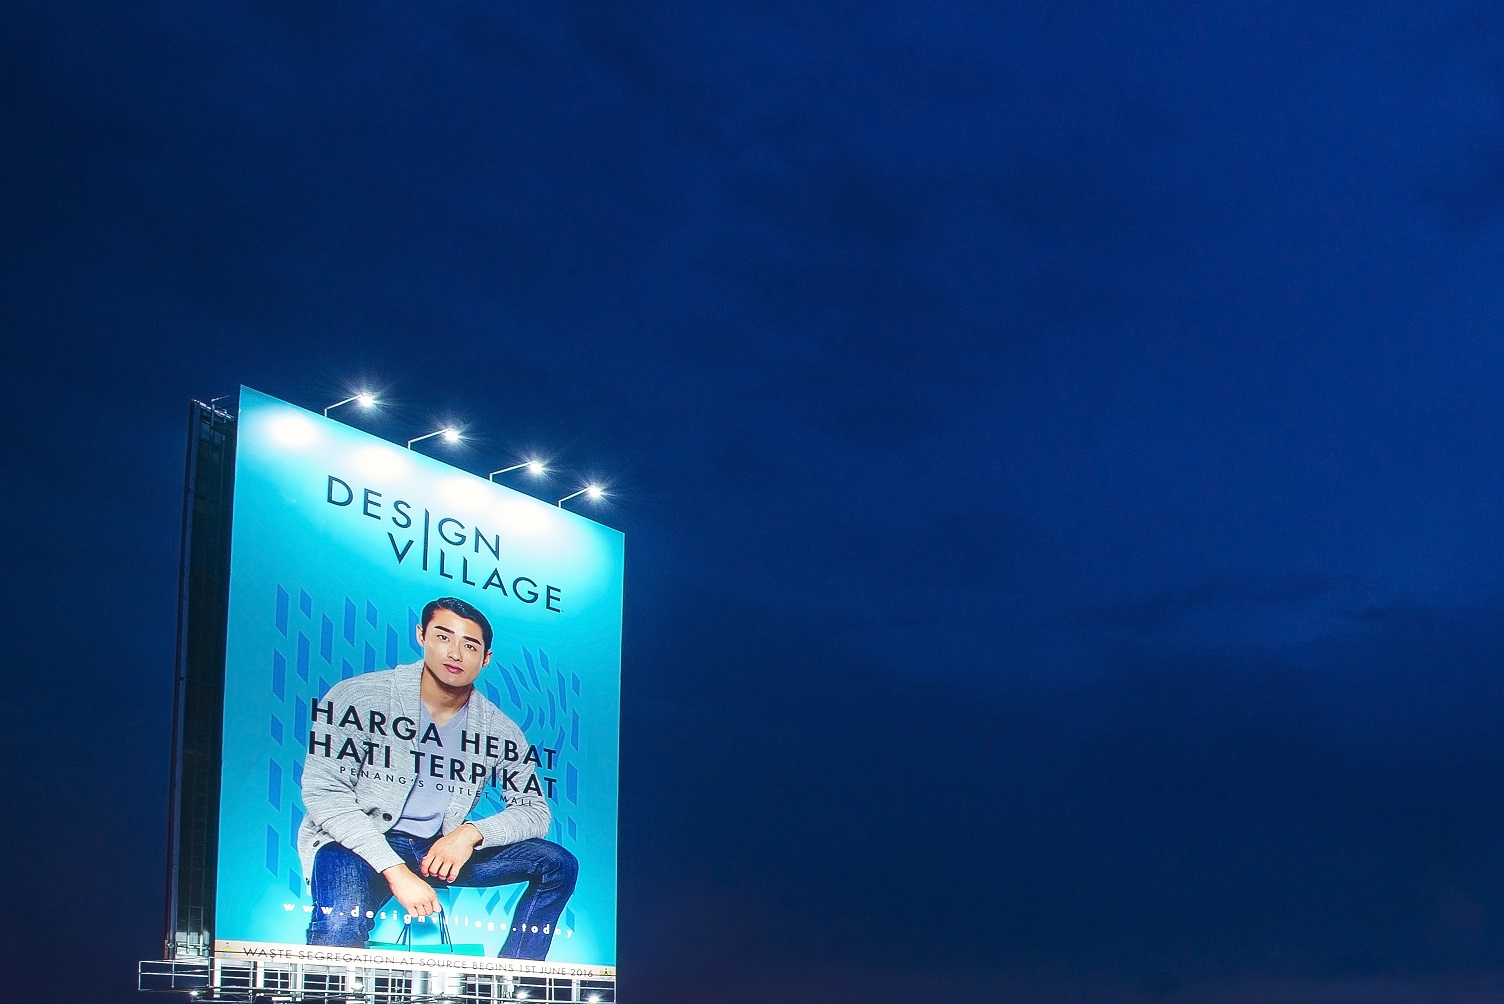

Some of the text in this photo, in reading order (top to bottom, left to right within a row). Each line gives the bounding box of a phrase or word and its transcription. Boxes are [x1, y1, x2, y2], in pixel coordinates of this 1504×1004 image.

[327, 475, 500, 565] DESIGN
[387, 528, 562, 613] VILLAGE
[308, 731, 557, 798] HATI TERPIKAT
[311, 698, 557, 770] HARGA HEBAT
[339, 766, 534, 808] PENANG'S OUTLET MALL
[243, 947, 594, 978] WASTE SEGREGATION AT SOURCE BEGINS 1ST JUNE 2016
